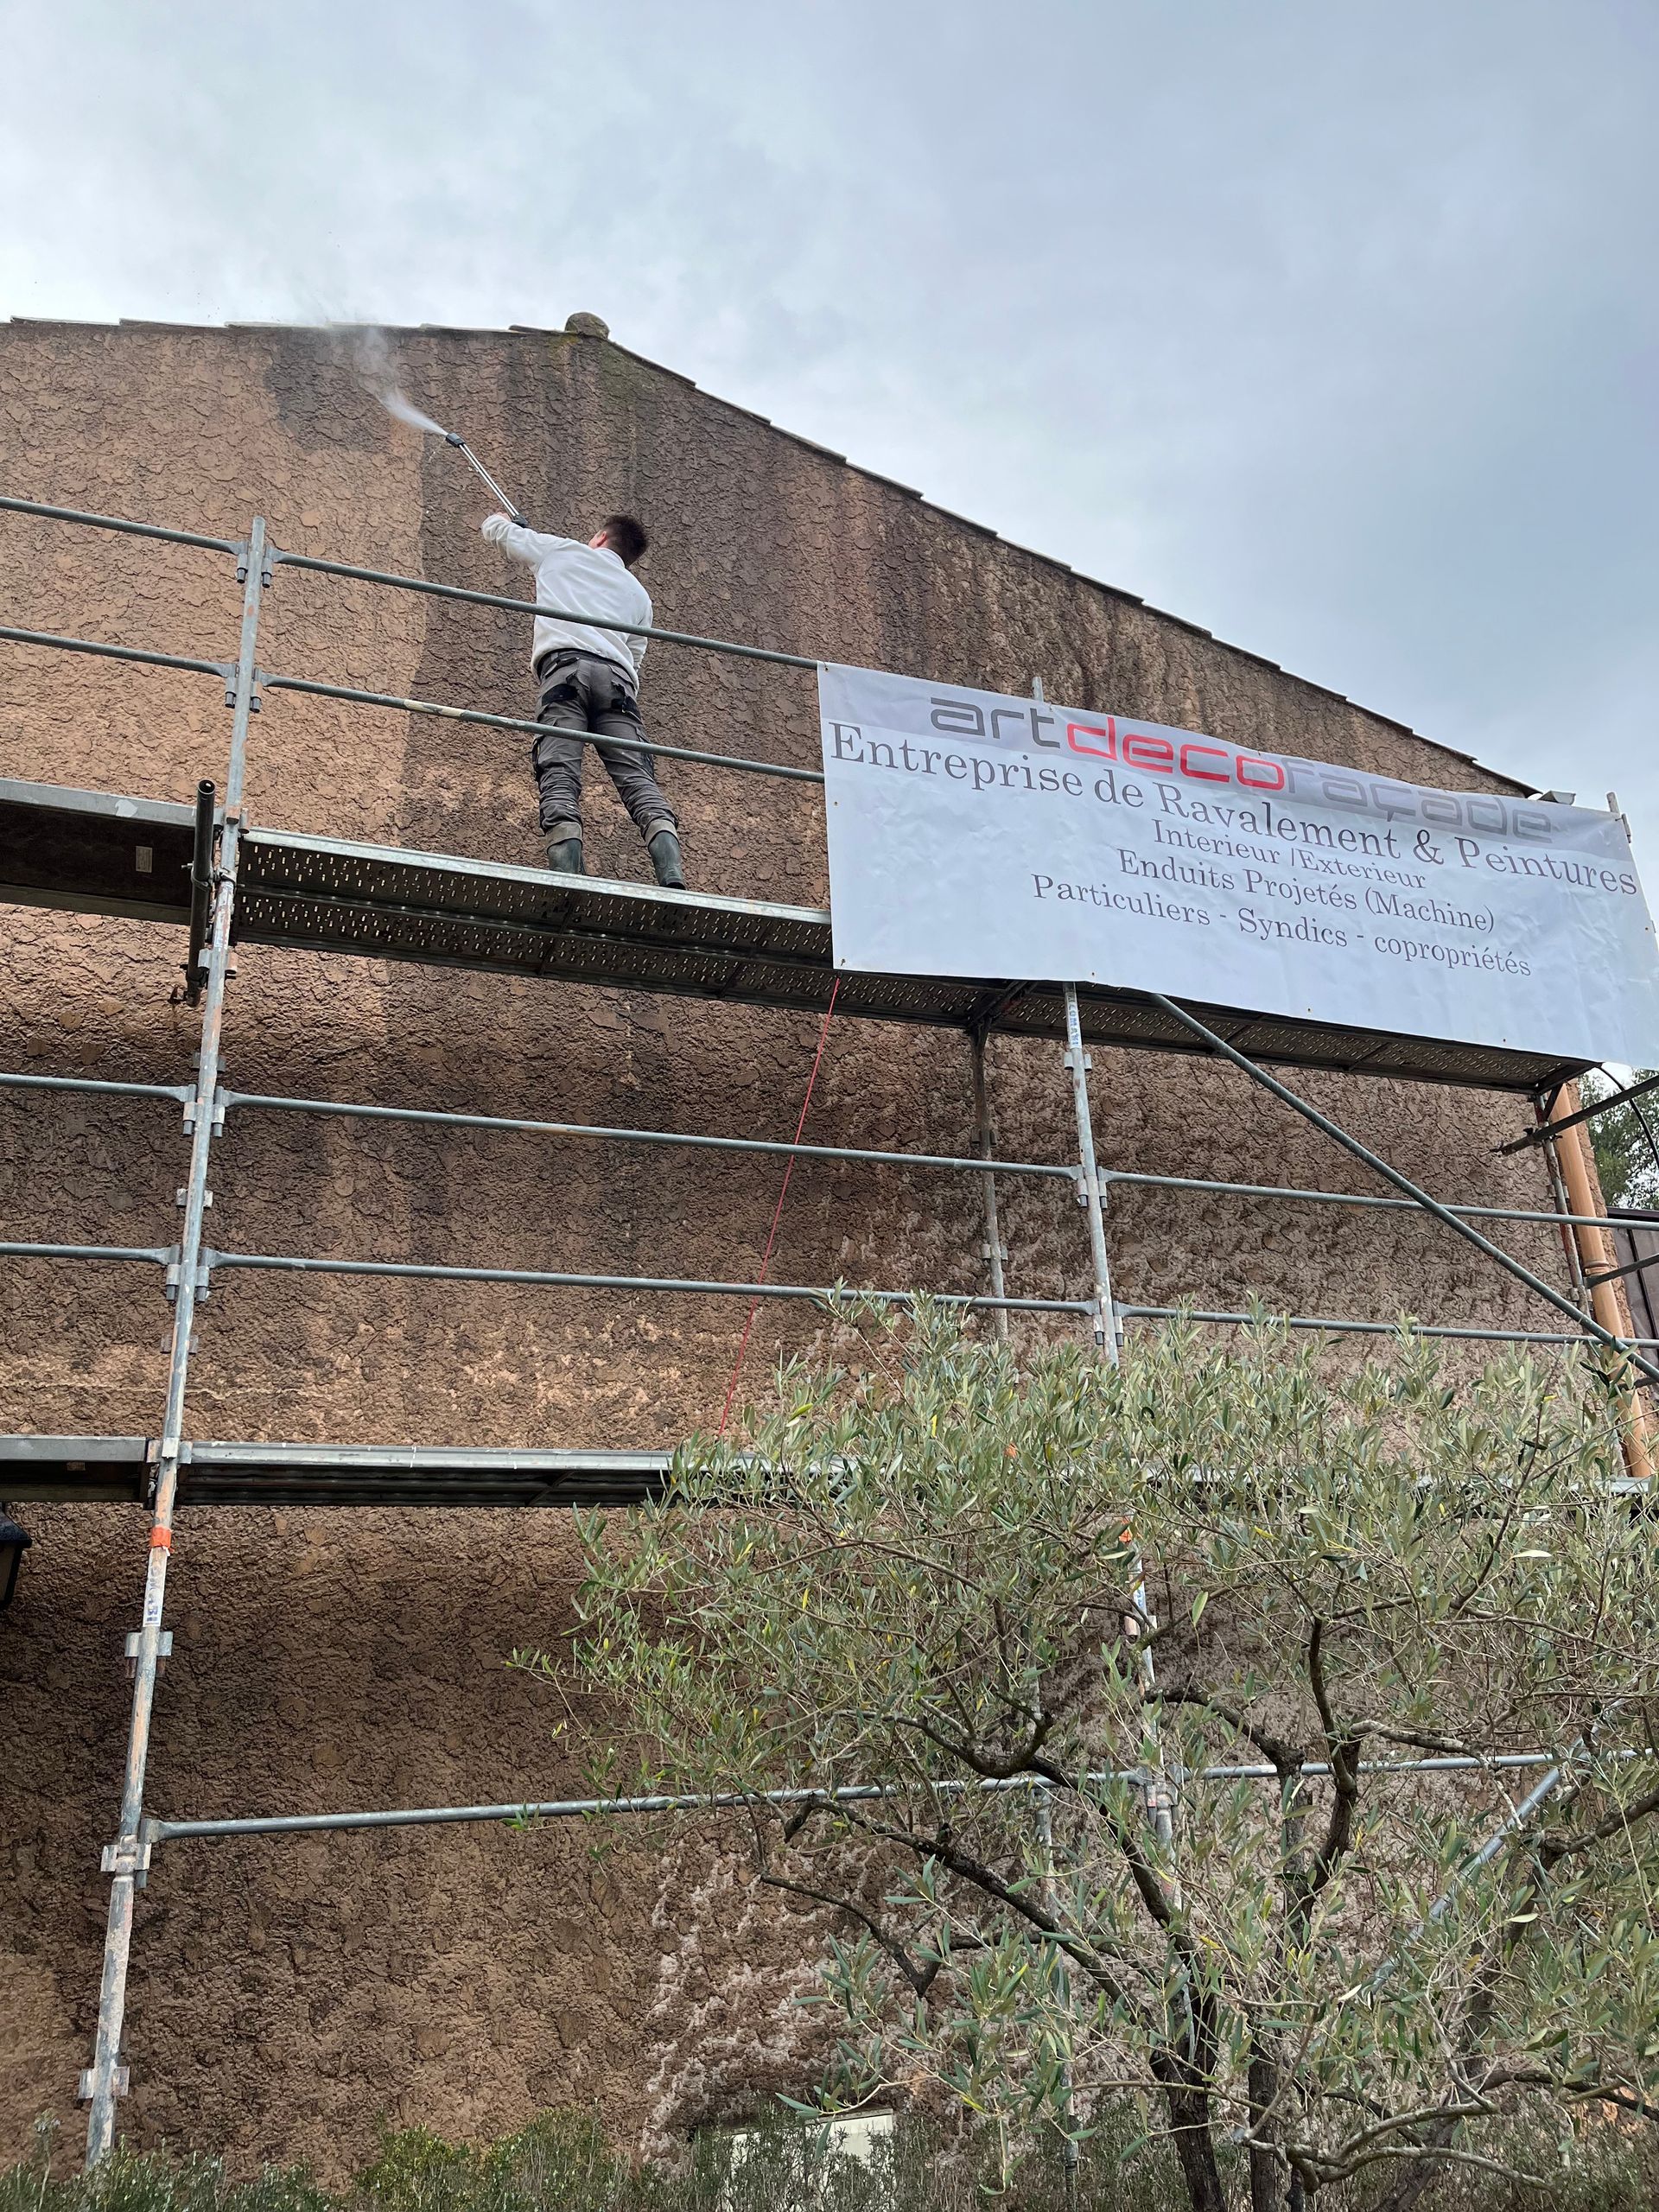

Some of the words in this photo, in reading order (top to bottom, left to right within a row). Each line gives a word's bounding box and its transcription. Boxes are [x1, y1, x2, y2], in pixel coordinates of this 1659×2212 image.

[829, 721, 1083, 797] Entreprise
[1094, 769, 1144, 808] de
[1153, 781, 1402, 860] Ravalement
[1413, 829, 1445, 866] &
[1454, 836, 1637, 895] Peintures
[1151, 818, 1281, 864] Interieur
[1031, 874, 1211, 925] Particuliers
[1237, 907, 1348, 948] Syndics
[1374, 932, 1532, 976] copropriétés
[1116, 848, 1235, 890] Enduits
[1243, 868, 1357, 910] Projetés
[1365, 886, 1495, 934] (Machine)
